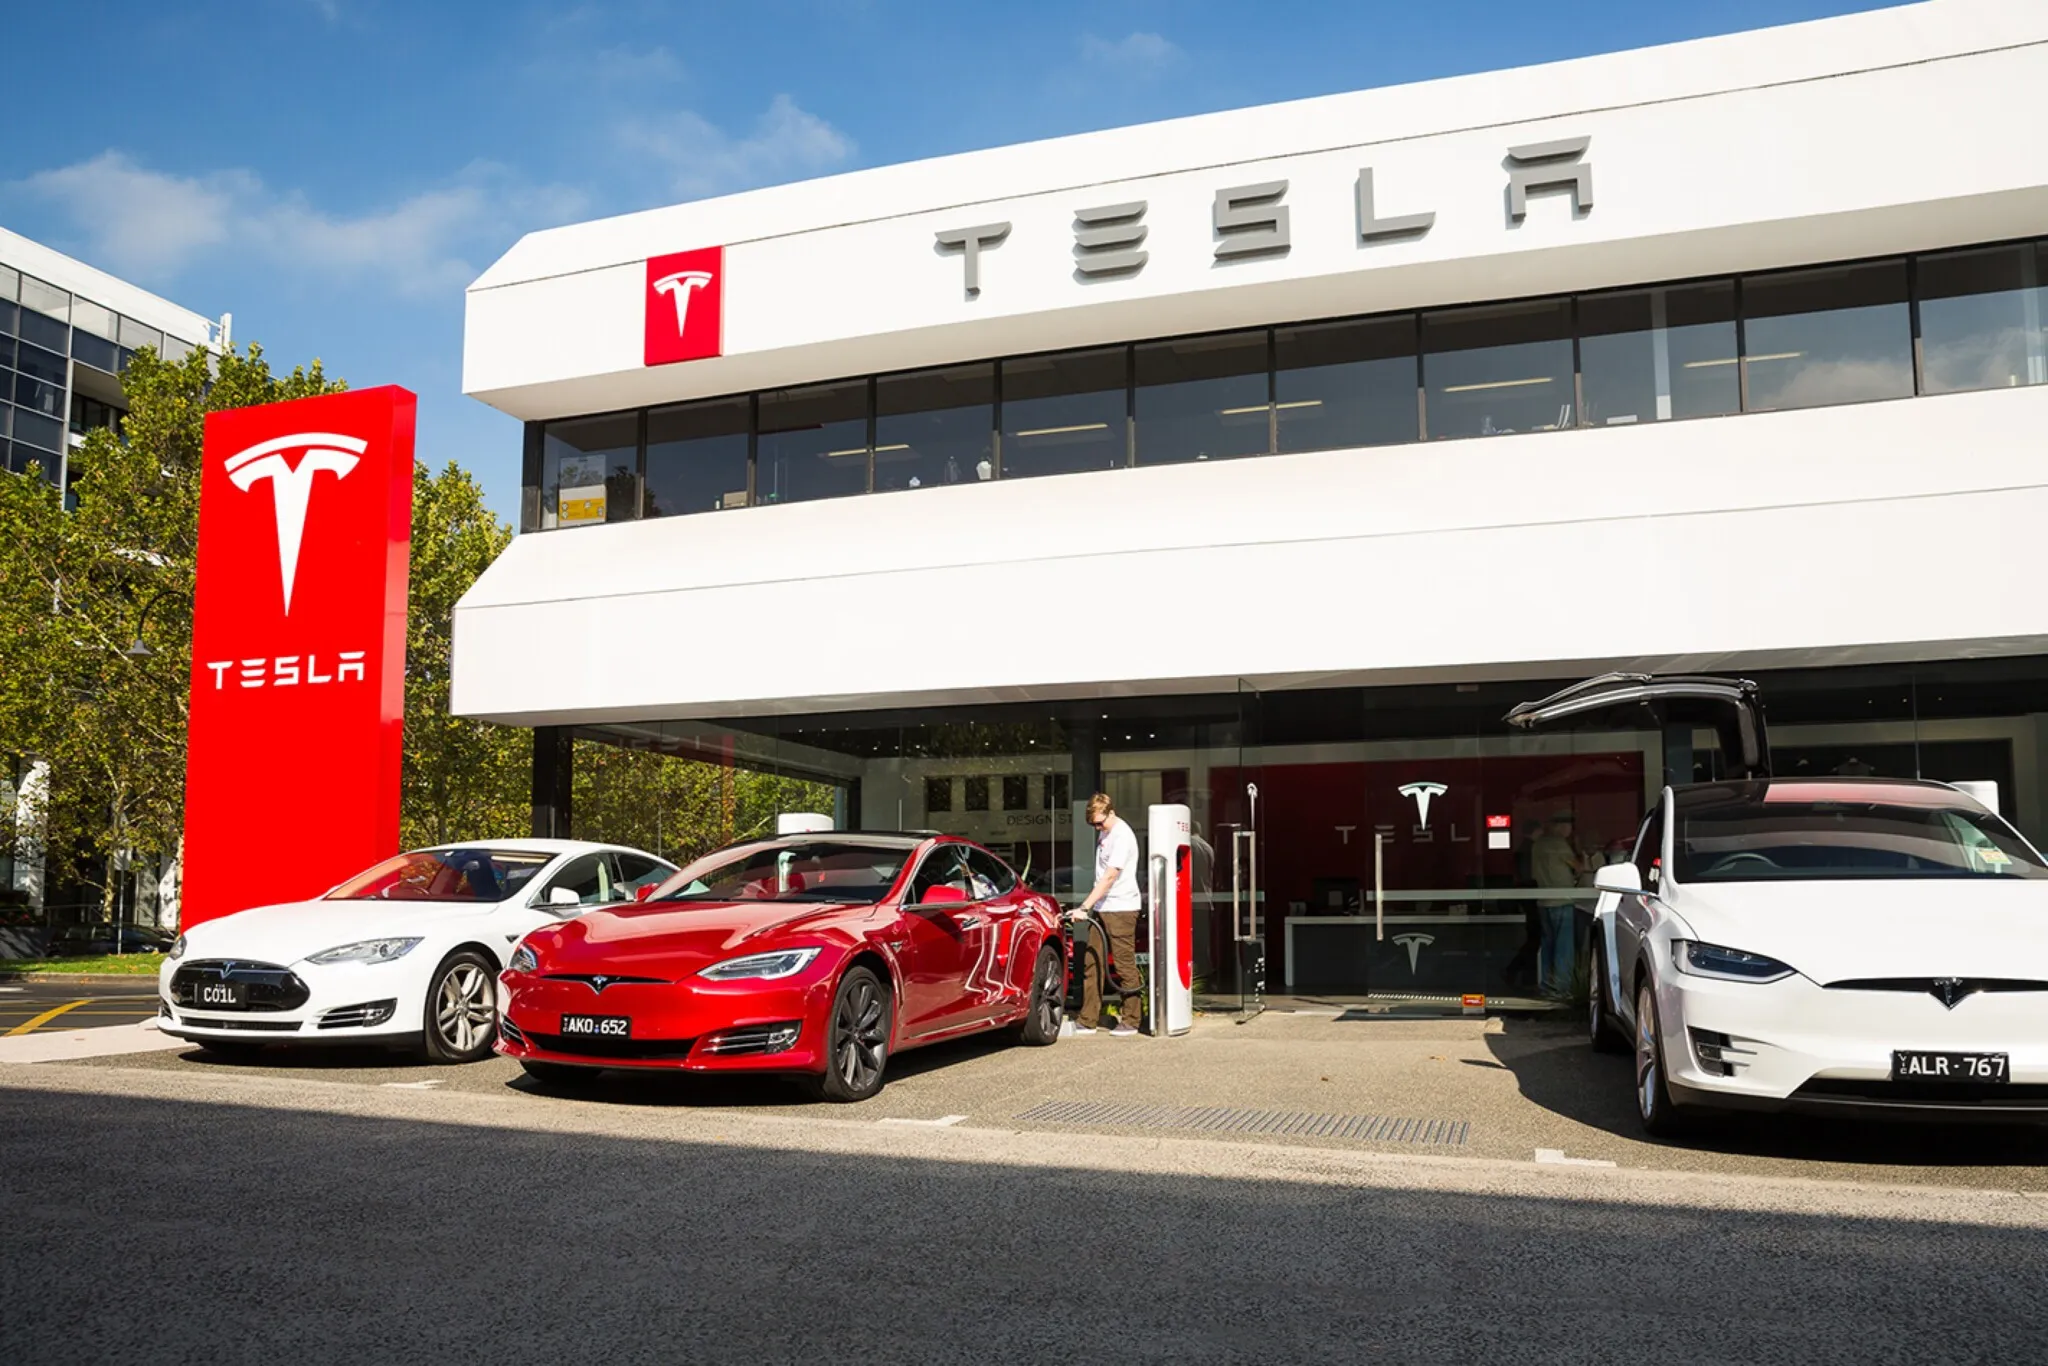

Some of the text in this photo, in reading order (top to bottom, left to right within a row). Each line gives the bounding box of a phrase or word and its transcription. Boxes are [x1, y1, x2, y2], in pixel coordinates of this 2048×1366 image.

[935, 135, 1593, 296] TESLA
[206, 651, 366, 690] TESLA
[1006, 814, 1052, 825] DESIGN
[1334, 823, 1472, 844] TESL
